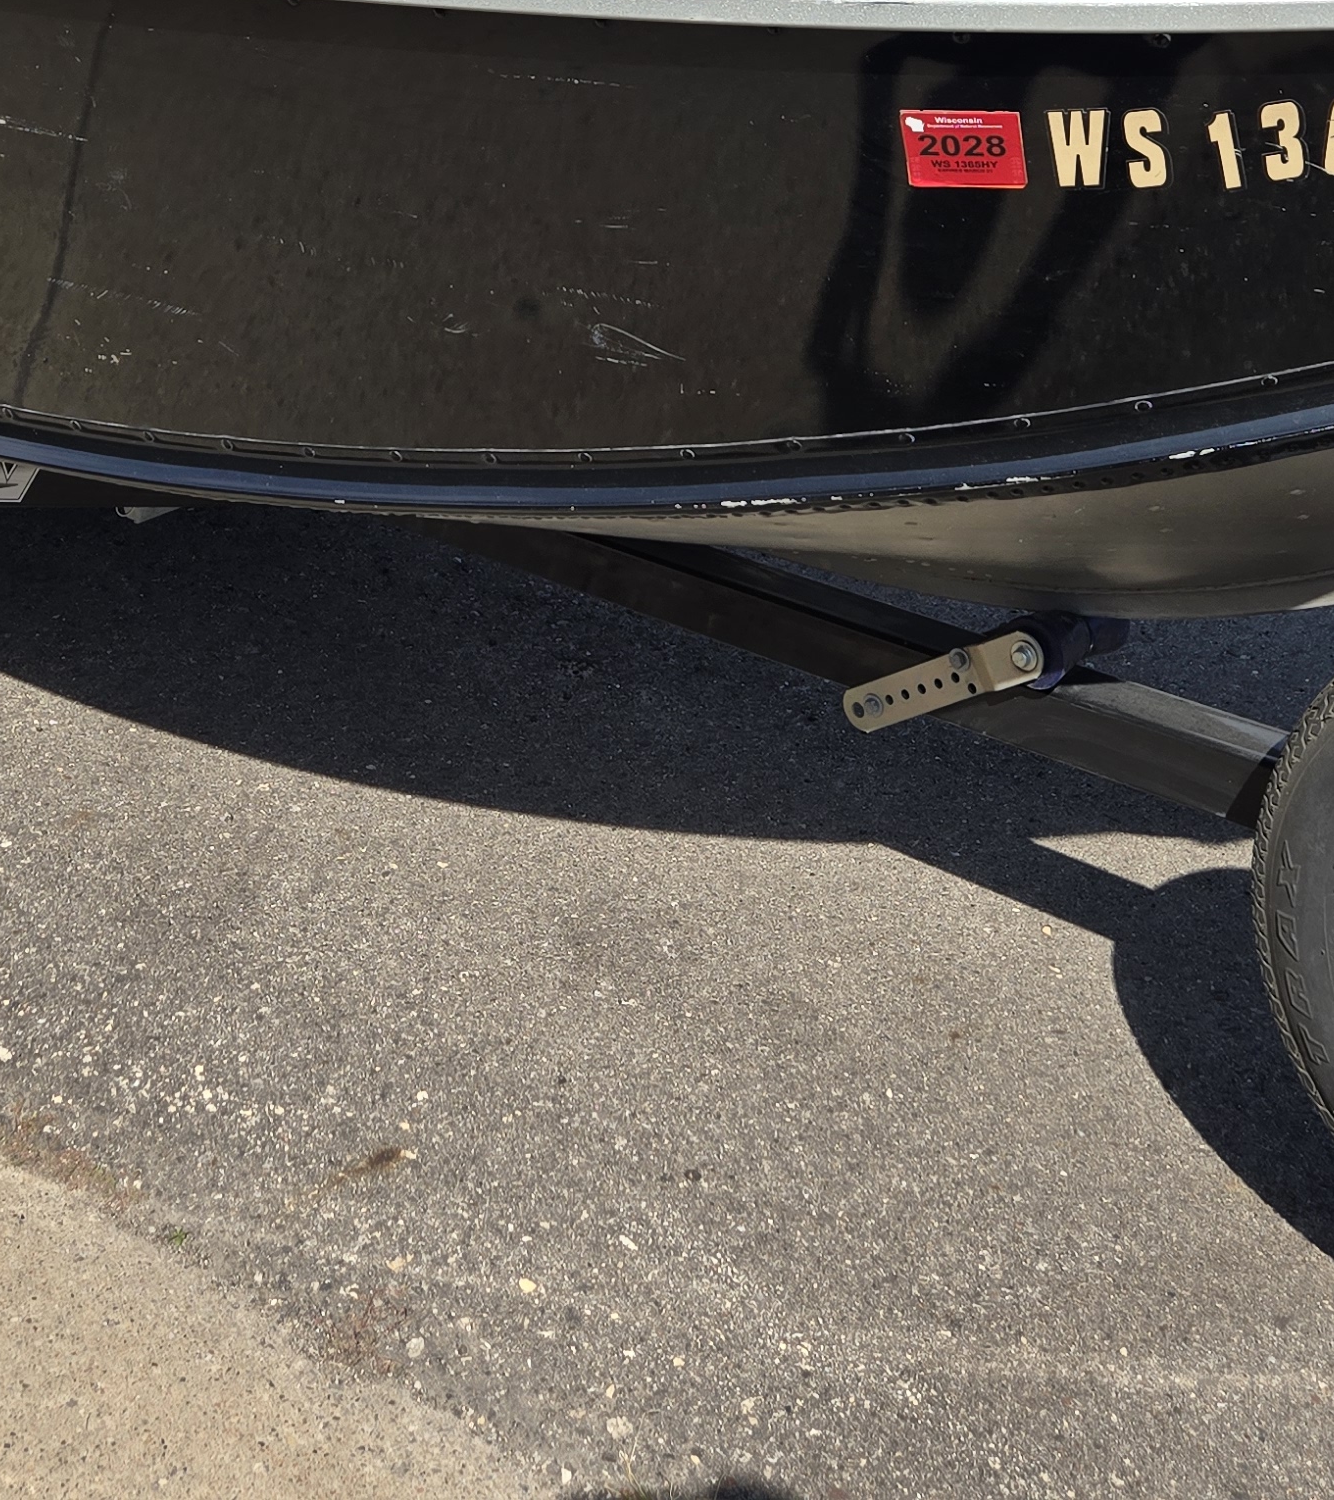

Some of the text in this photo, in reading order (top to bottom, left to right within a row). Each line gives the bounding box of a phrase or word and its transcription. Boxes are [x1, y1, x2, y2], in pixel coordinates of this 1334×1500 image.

[934, 116, 983, 124] Wisconsin
[917, 135, 1007, 156] 2028
[1047, 108, 1168, 188] WS
[931, 159, 951, 168] WS
